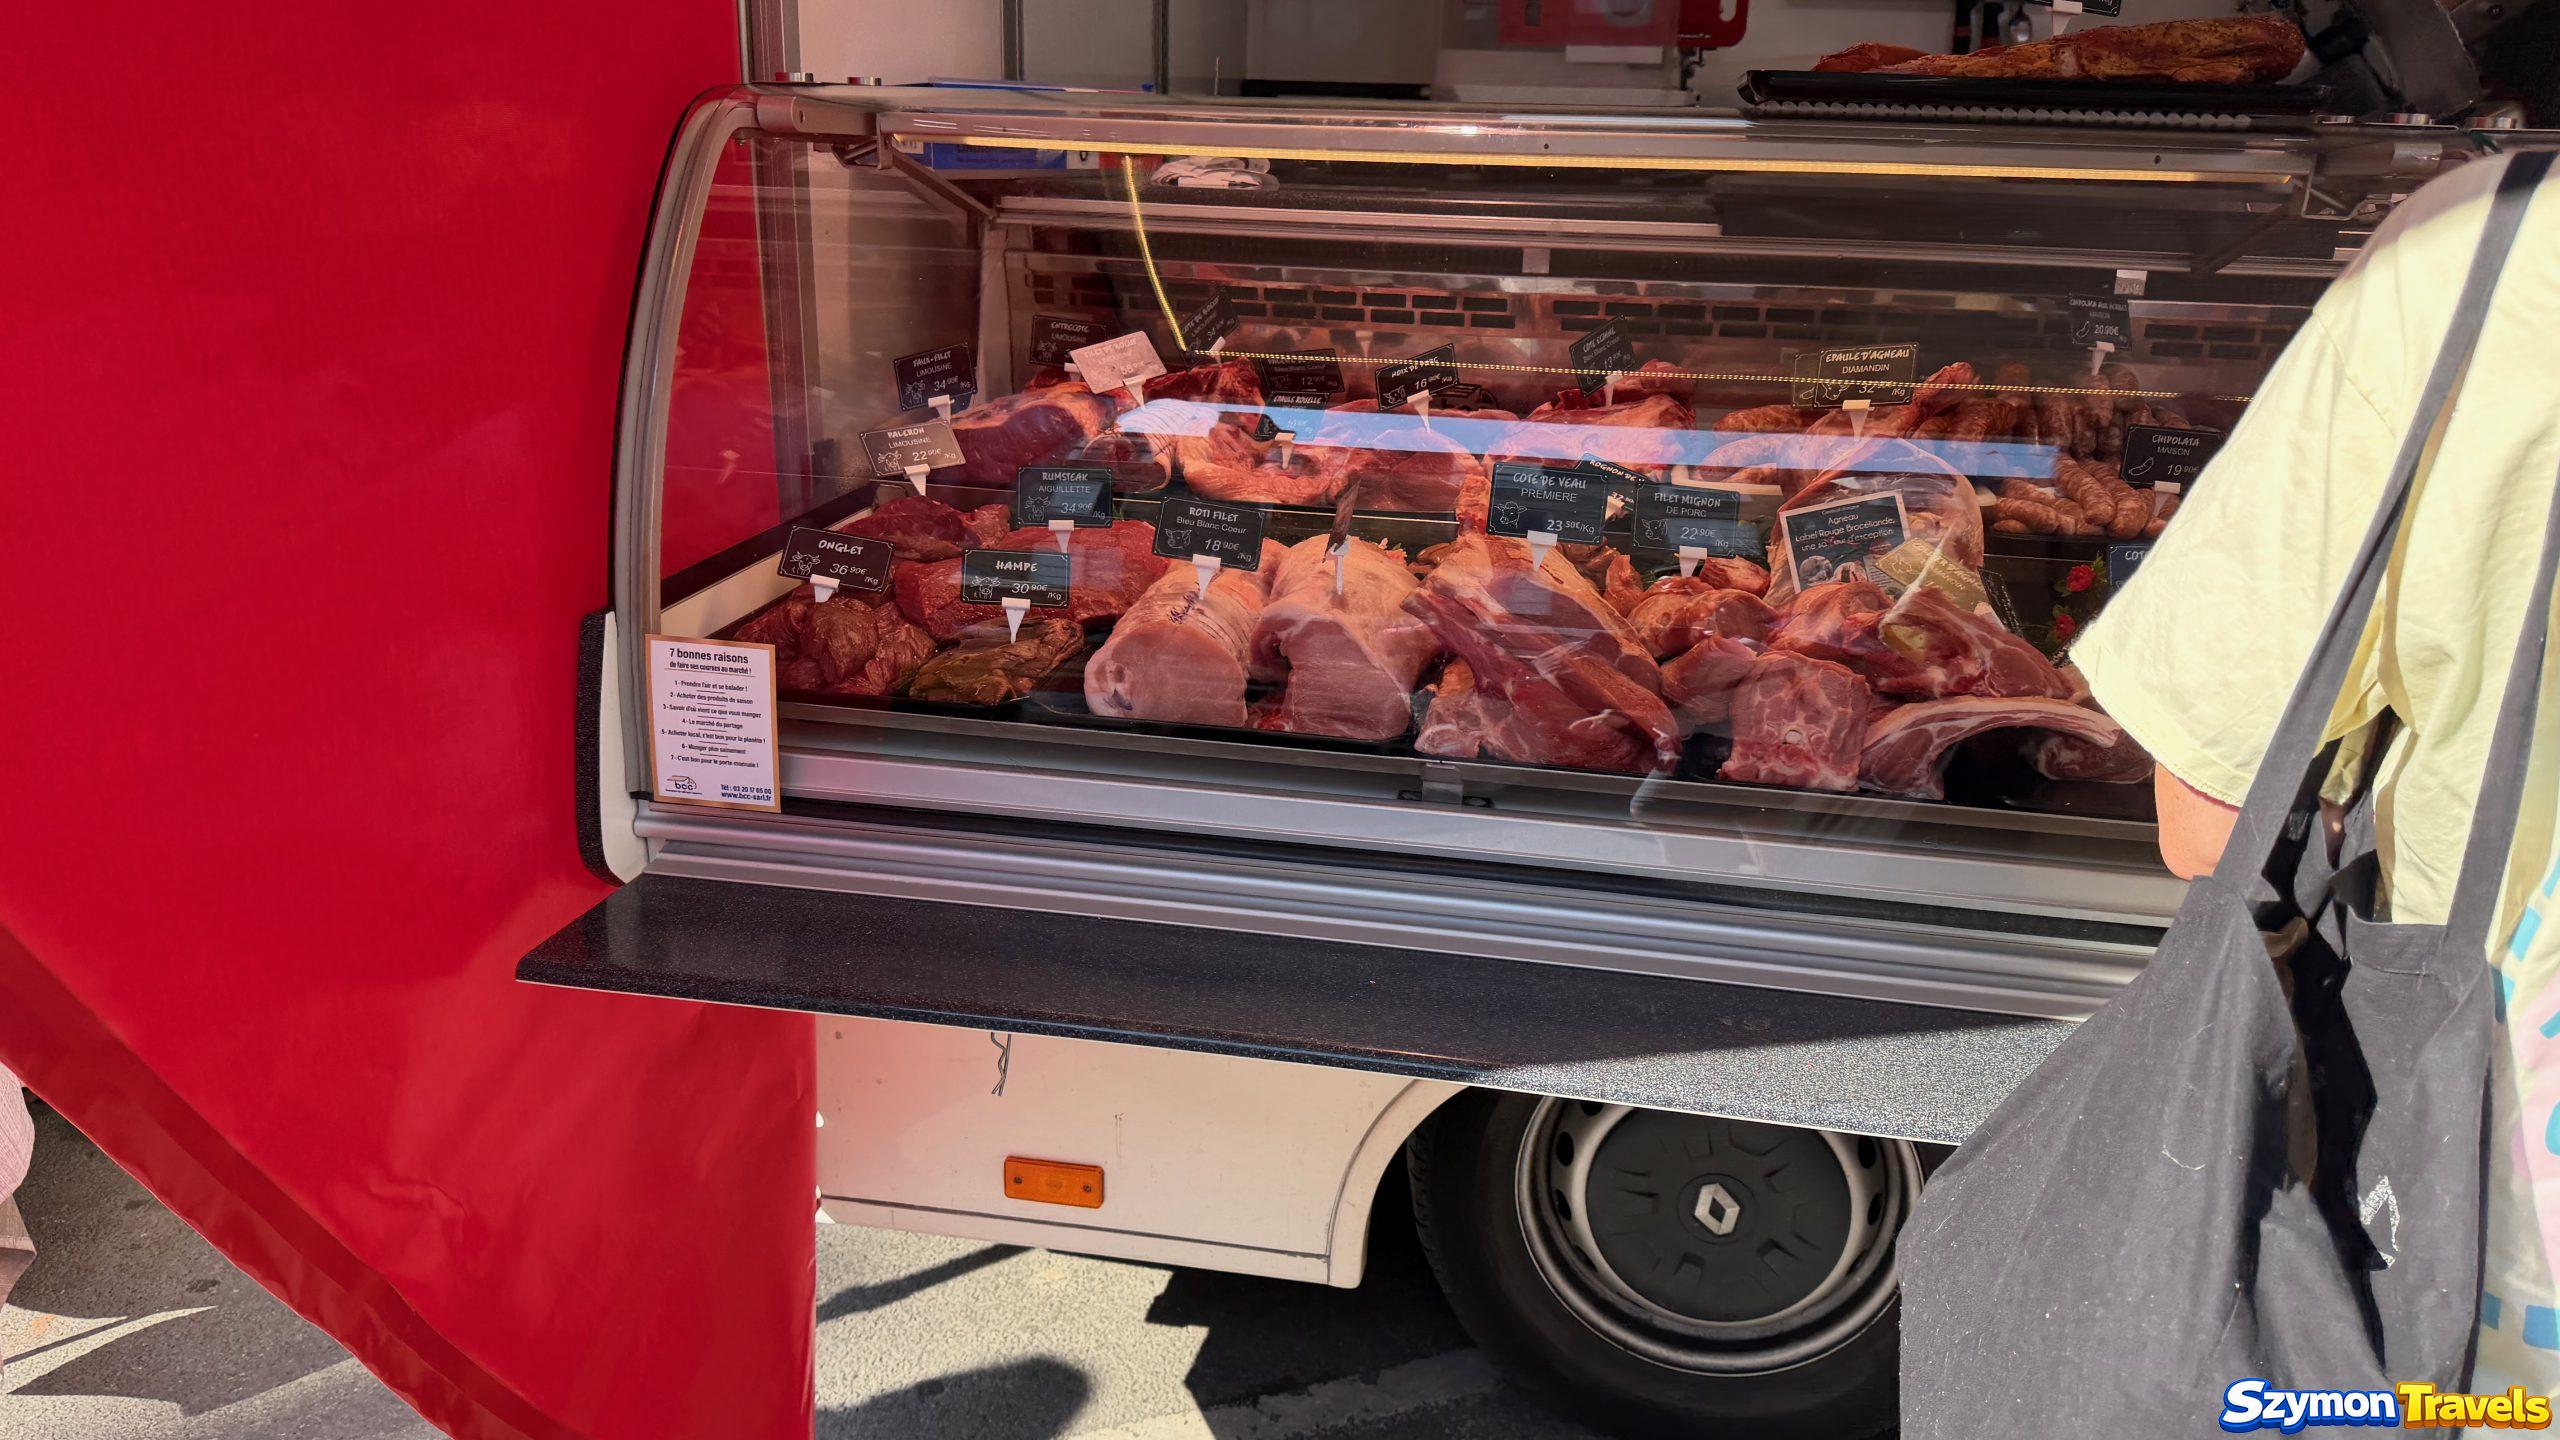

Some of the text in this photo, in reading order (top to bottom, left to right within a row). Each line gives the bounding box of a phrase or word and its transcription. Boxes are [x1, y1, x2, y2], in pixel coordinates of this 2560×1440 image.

[912, 350, 952, 367] FAUX-FILET
[1826, 349, 1909, 362] EPAULE D'AGNEAU
[916, 362, 953, 378] LIMOUSINE
[1842, 364, 1890, 374] DIAMANDIN
[934, 380, 946, 391] 34
[1415, 378, 1427, 390] 16
[887, 427, 925, 439] PALERON
[888, 437, 933, 449] LIMOUSINE
[2152, 434, 2200, 447] CHIPOLATA
[912, 451, 928, 461] 22
[2157, 446, 2191, 456] MAISON
[1589, 459, 1624, 476] ROGNON
[2167, 464, 2182, 476] 19
[1042, 472, 1089, 481] RUMSTEAK
[1513, 472, 1587, 489] COTE DE VEAU
[1038, 485, 1091, 494] AIGUILLETTE
[1521, 488, 1578, 502] PREMIERE
[1654, 492, 1721, 507] FILET MIGNON
[1061, 502, 1077, 514] 34
[1189, 506, 1239, 522] ROTI FILET
[1666, 505, 1707, 517] DE PORC
[1176, 516, 1248, 534] Bleu Blanc Coeur
[1546, 519, 1563, 532] 23
[1828, 514, 1859, 526] Agneau
[1681, 526, 1699, 540] 22
[1795, 530, 1818, 542] Label
[1819, 526, 1846, 538] Rouge
[818, 540, 864, 555] ONGLET
[1205, 538, 1222, 552] 18
[829, 563, 849, 575] 36
[995, 560, 1038, 572] HAMPE
[1011, 582, 1030, 594] 30
[670, 648, 749, 664] 7 bonnes raisons
[677, 661, 690, 669] faire
[699, 664, 721, 672] courses
[728, 666, 749, 675] marché
[675, 780, 694, 791] bcc
